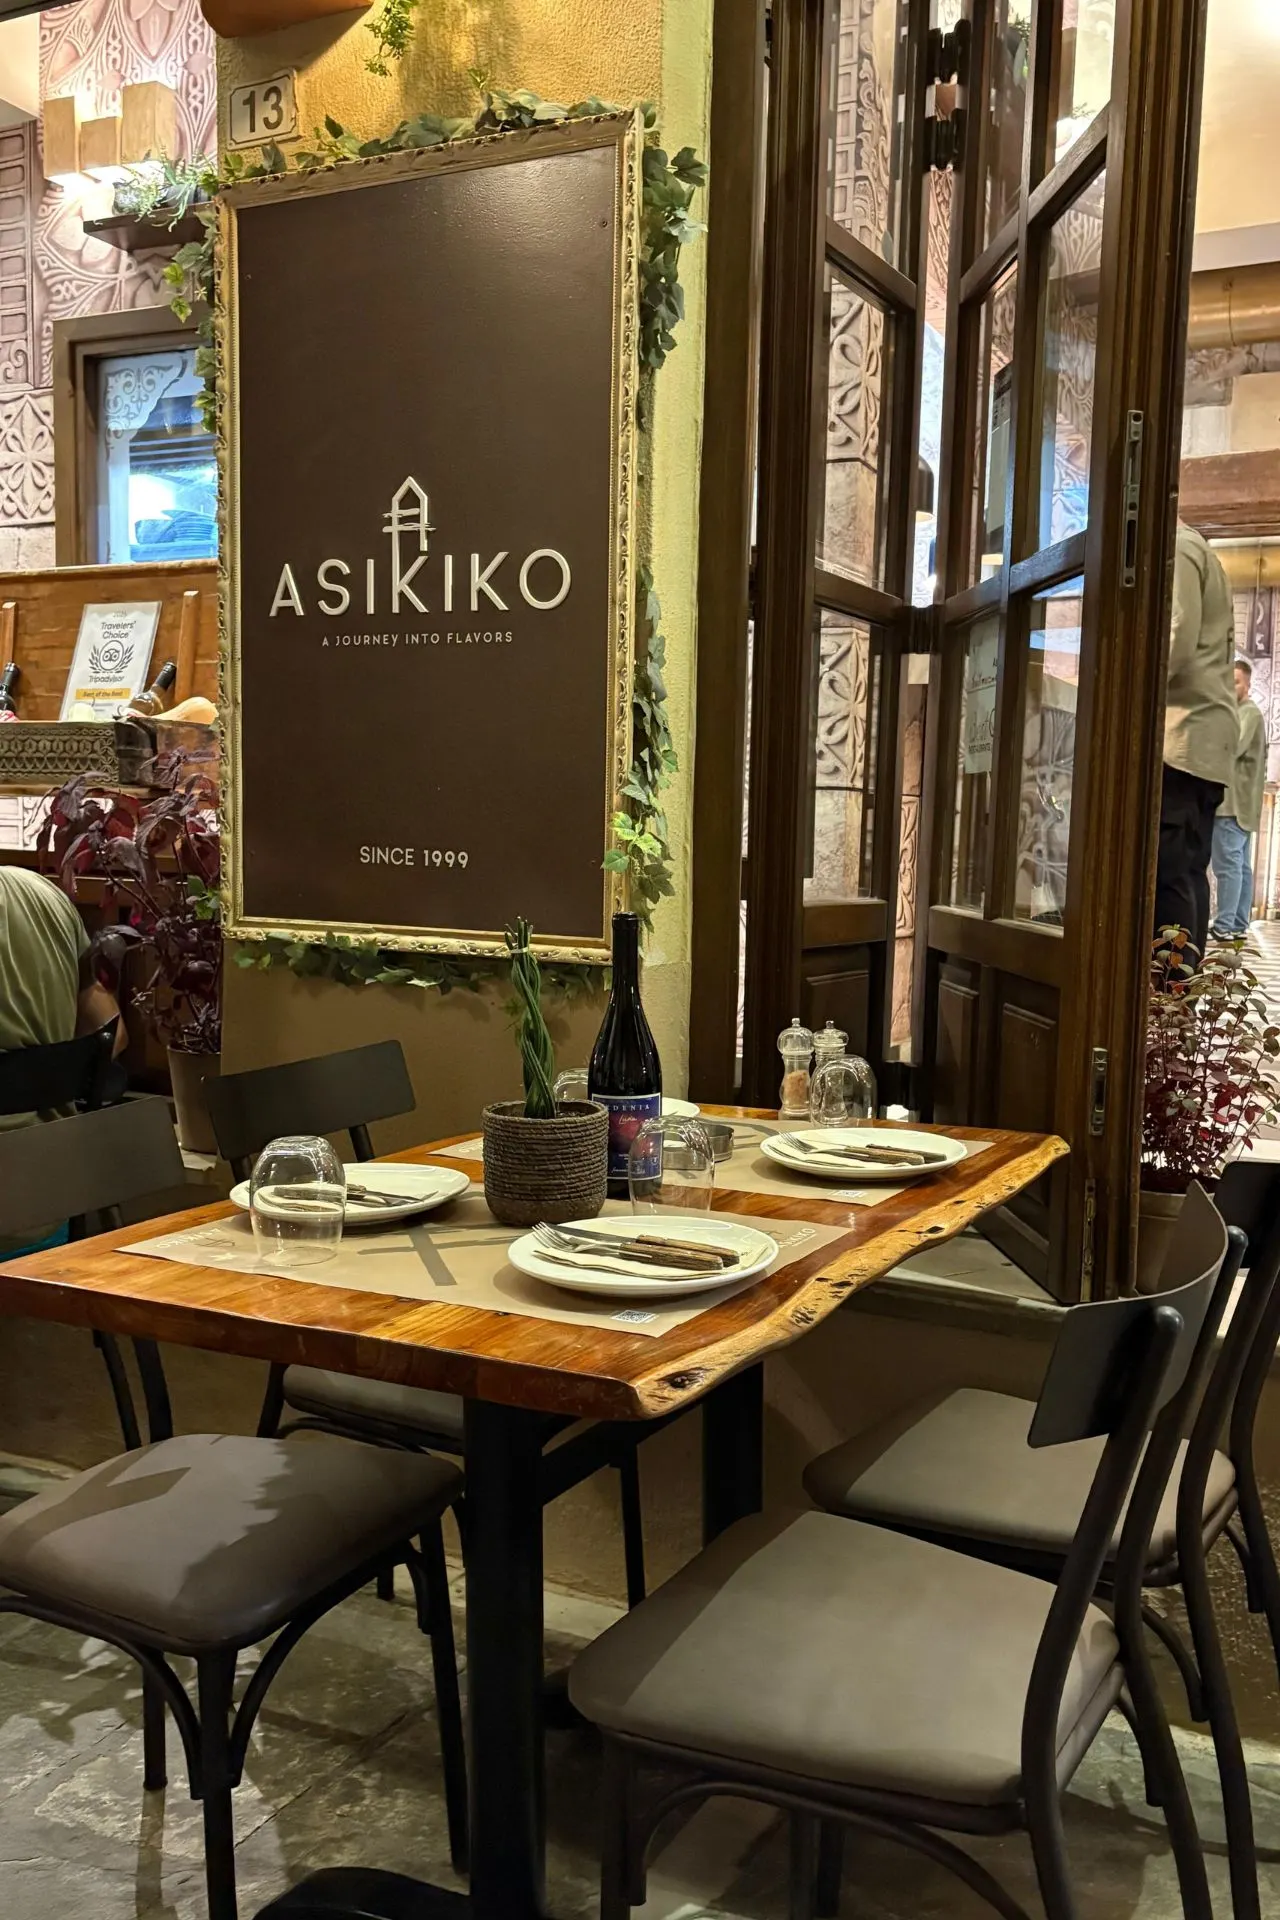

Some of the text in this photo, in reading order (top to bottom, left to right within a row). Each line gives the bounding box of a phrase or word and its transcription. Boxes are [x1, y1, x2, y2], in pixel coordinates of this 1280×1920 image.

[242, 85, 284, 133] 13
[269, 547, 572, 617] ASIKIKO
[102, 630, 130, 640] Choice
[321, 631, 514, 647] A JOURNEY INTO FLAVORS
[89, 674, 125, 684] Tripadvisor
[359, 845, 470, 869] SINCE 1999
